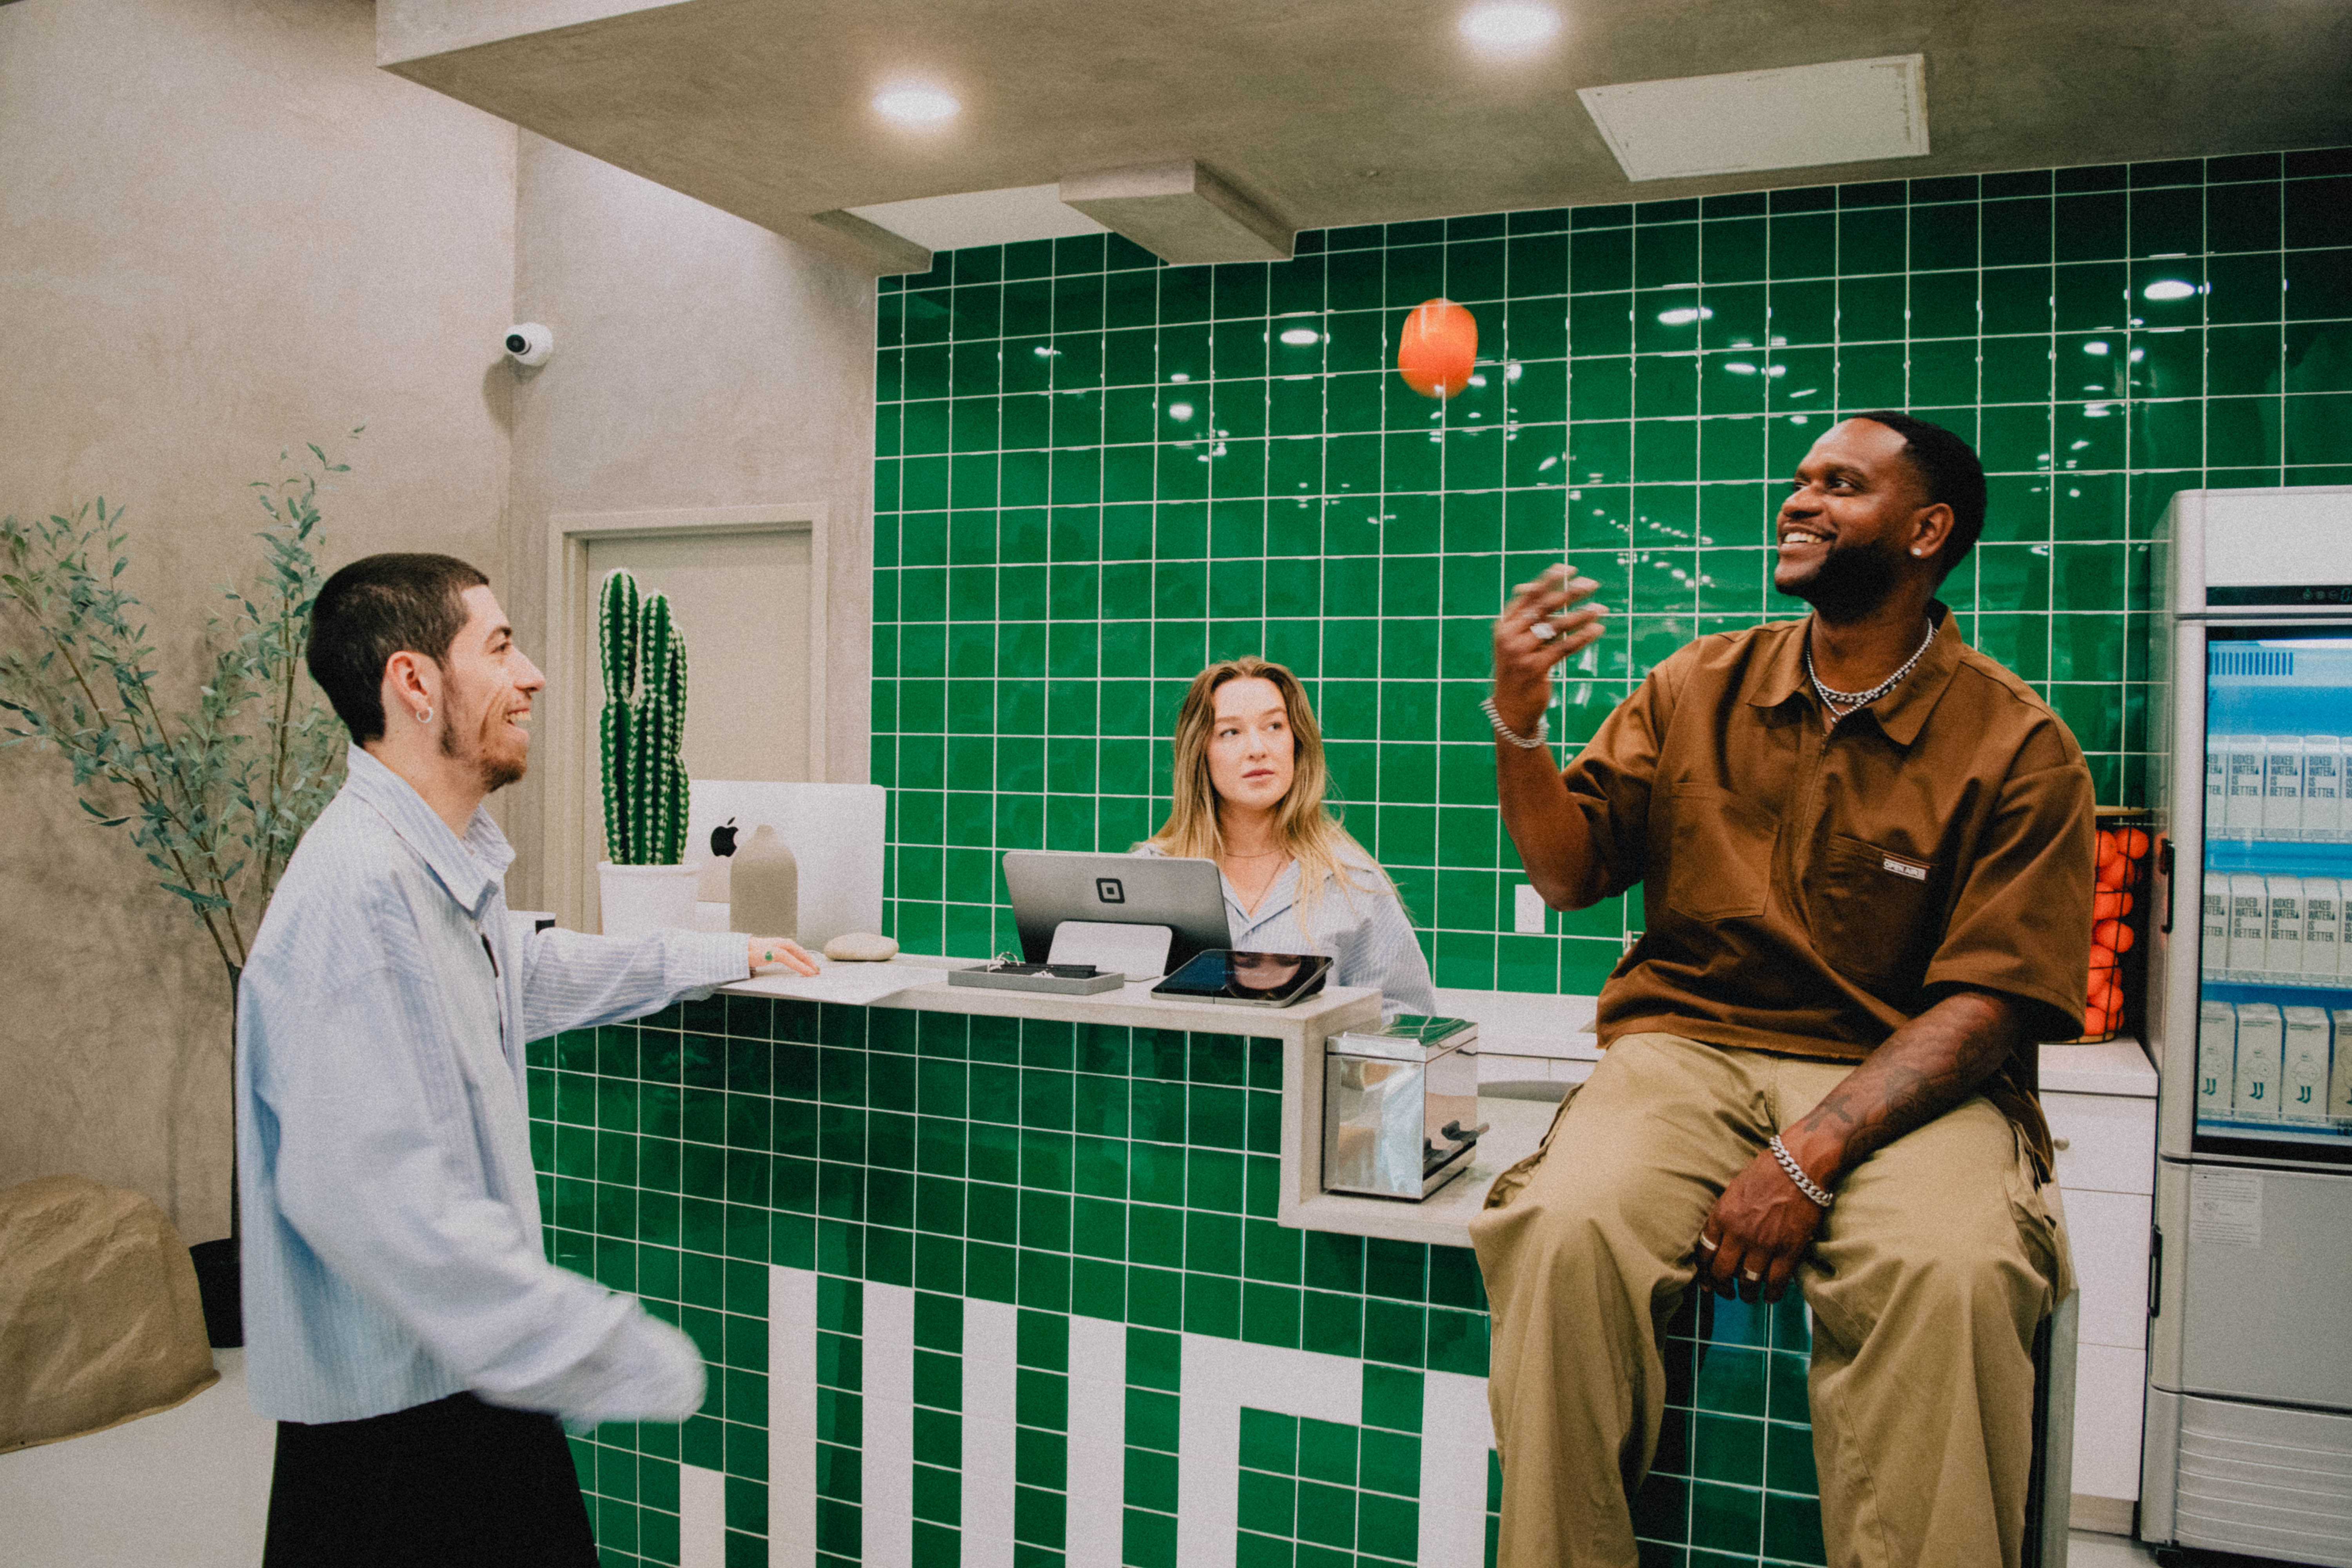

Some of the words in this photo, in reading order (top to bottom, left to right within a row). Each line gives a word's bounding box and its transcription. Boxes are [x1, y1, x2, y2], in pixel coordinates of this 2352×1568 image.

[2232, 755, 2255, 764] BOXED
[2271, 755, 2294, 765] BOXED
[2309, 756, 2332, 766] BOXED
[2232, 765, 2256, 775] WATER
[2271, 766, 2294, 776] WATER
[2309, 766, 2332, 777] WATER
[2232, 775, 2239, 785] IS
[2270, 776, 2277, 786] IS
[2308, 777, 2315, 786] IS
[2231, 786, 2258, 796] BETTER.
[2270, 786, 2298, 797] BETTER.
[2308, 788, 2335, 798] BETTER.
[1883, 861, 1904, 873] OPEN
[2235, 897, 2257, 907] BOXED
[2272, 898, 2295, 908] BOXED
[2308, 900, 2331, 910] BOXED
[2235, 907, 2258, 917] WATER
[2272, 909, 2296, 919] WATER
[2308, 910, 2332, 920] WATER
[2235, 918, 2241, 927] IS
[2272, 919, 2279, 929] IS
[2308, 920, 2315, 930] IS
[2271, 929, 2298, 940] BETTER.
